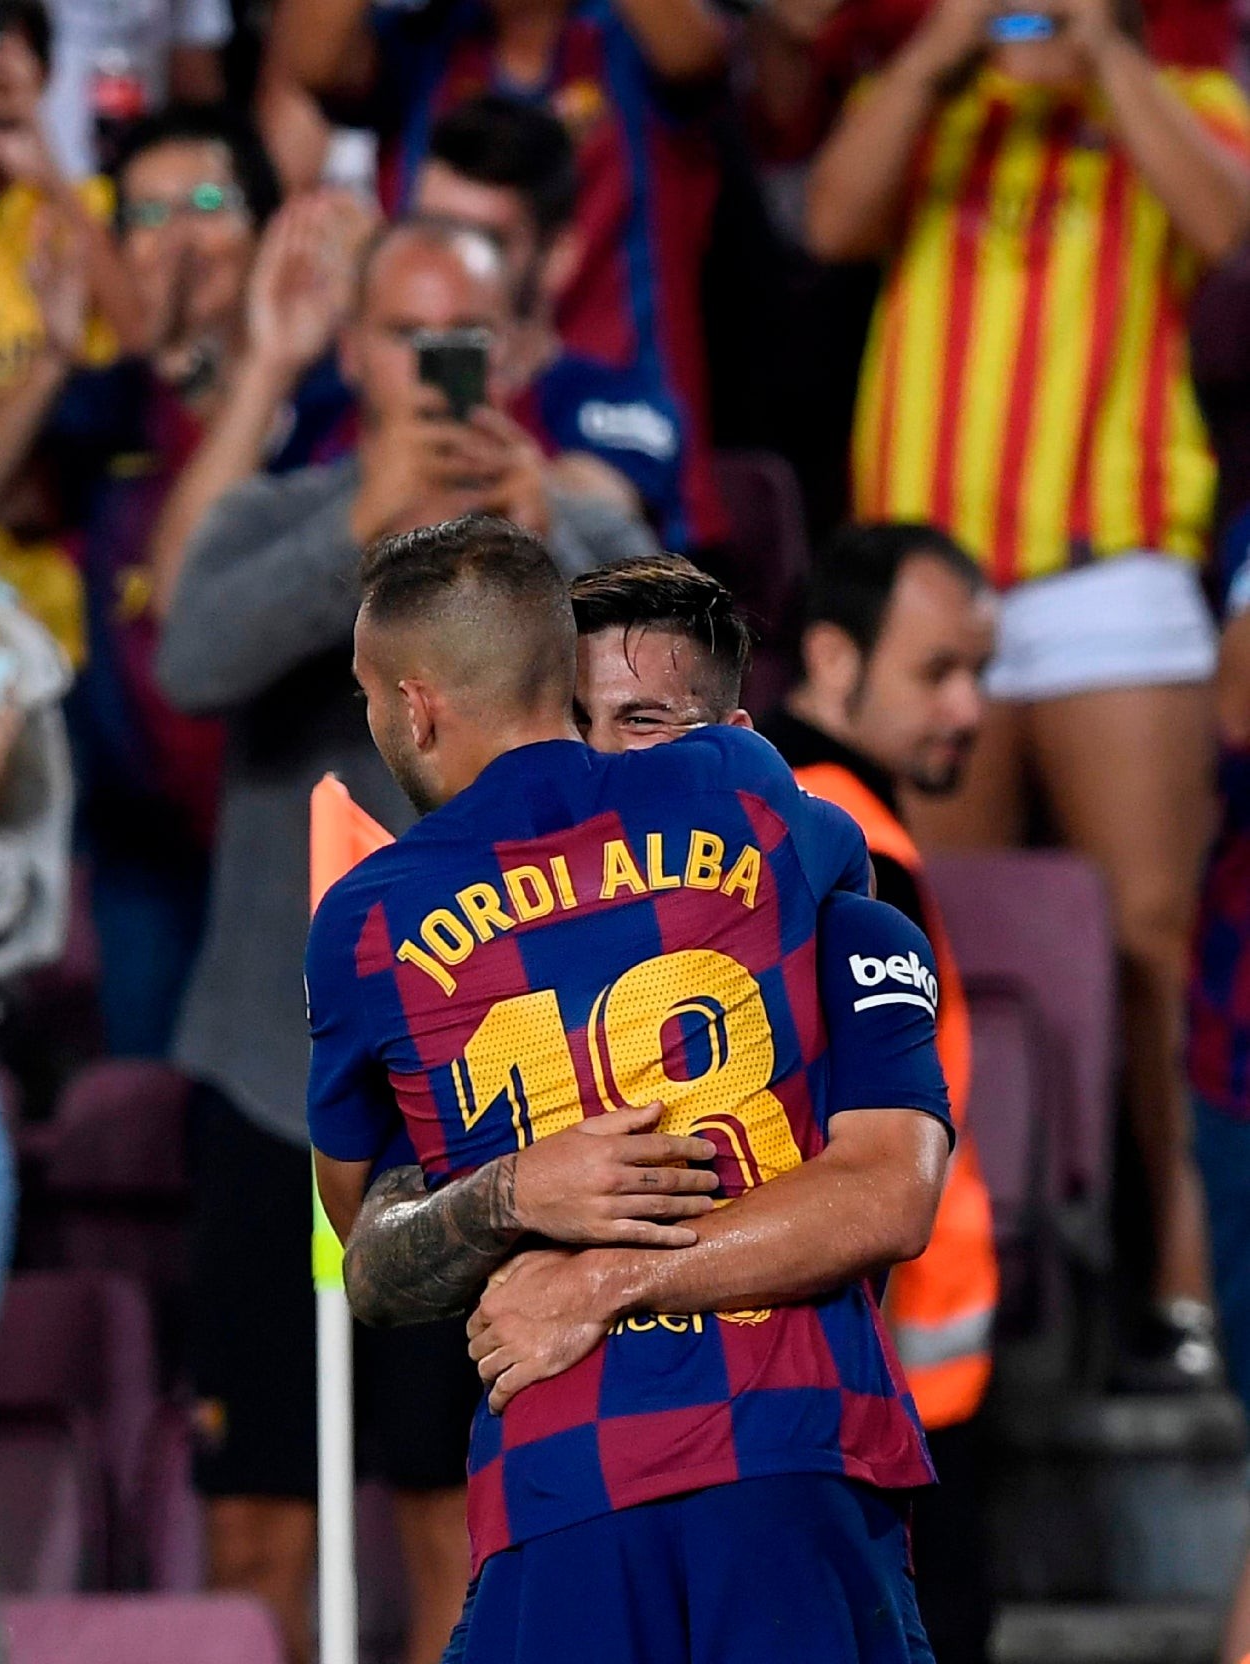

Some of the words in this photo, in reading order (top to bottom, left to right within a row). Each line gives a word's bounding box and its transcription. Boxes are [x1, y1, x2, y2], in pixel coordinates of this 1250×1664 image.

[396, 854, 579, 997] JORDI
[598, 829, 762, 909] ALBA
[848, 950, 938, 1008] beko
[450, 948, 803, 1210] 18
